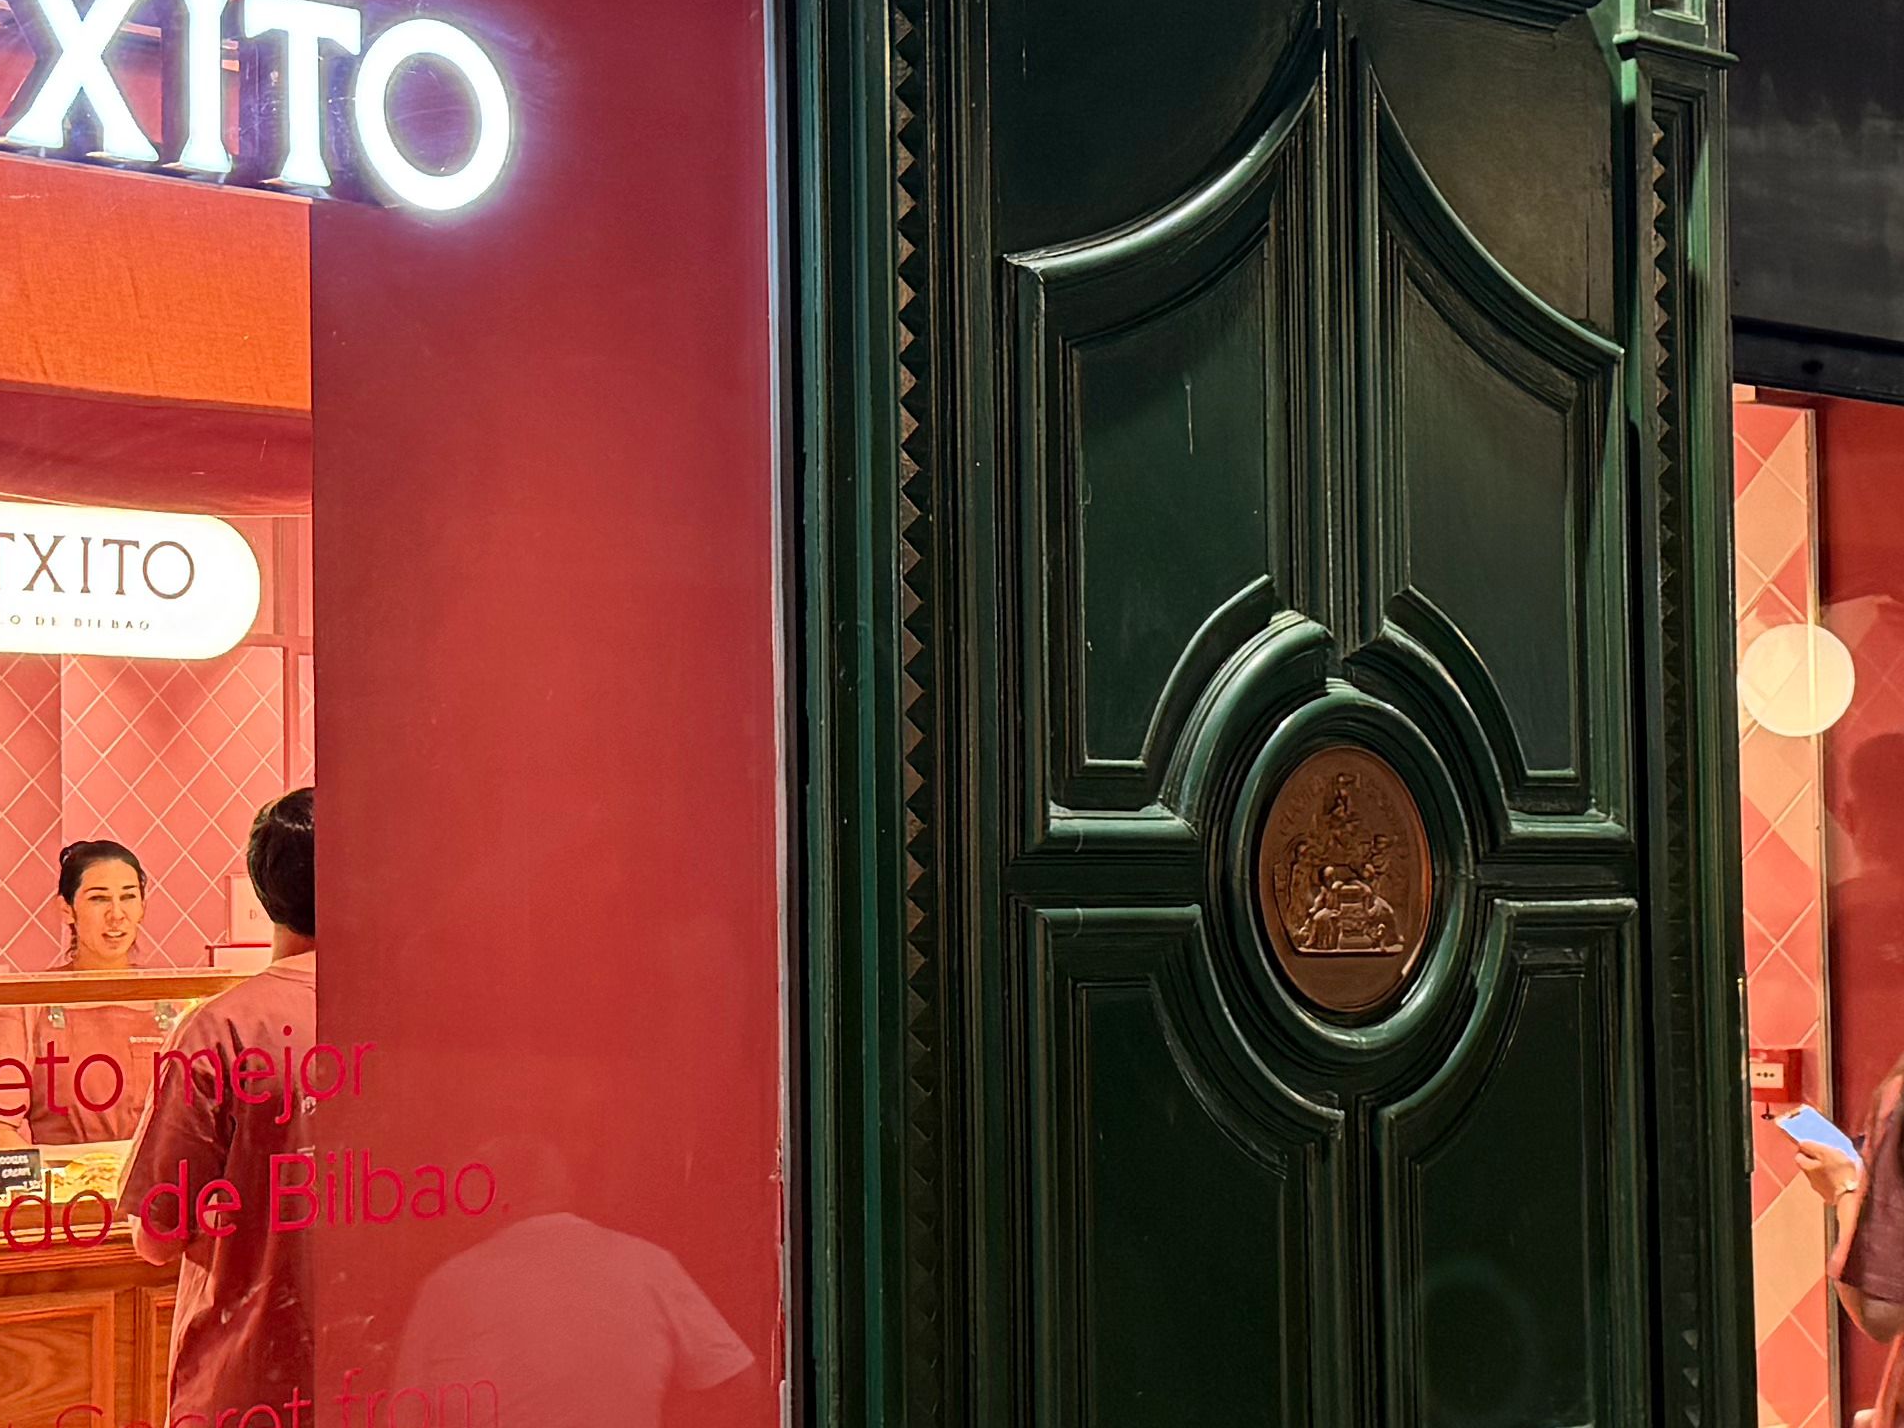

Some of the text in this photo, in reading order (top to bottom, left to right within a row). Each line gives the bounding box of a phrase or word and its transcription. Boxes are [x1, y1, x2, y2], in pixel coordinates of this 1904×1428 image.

[35, 615, 58, 627] DE
[74, 617, 151, 631] BILBAO
[152, 1025, 377, 1124] mejor
[140, 1159, 242, 1240] de
